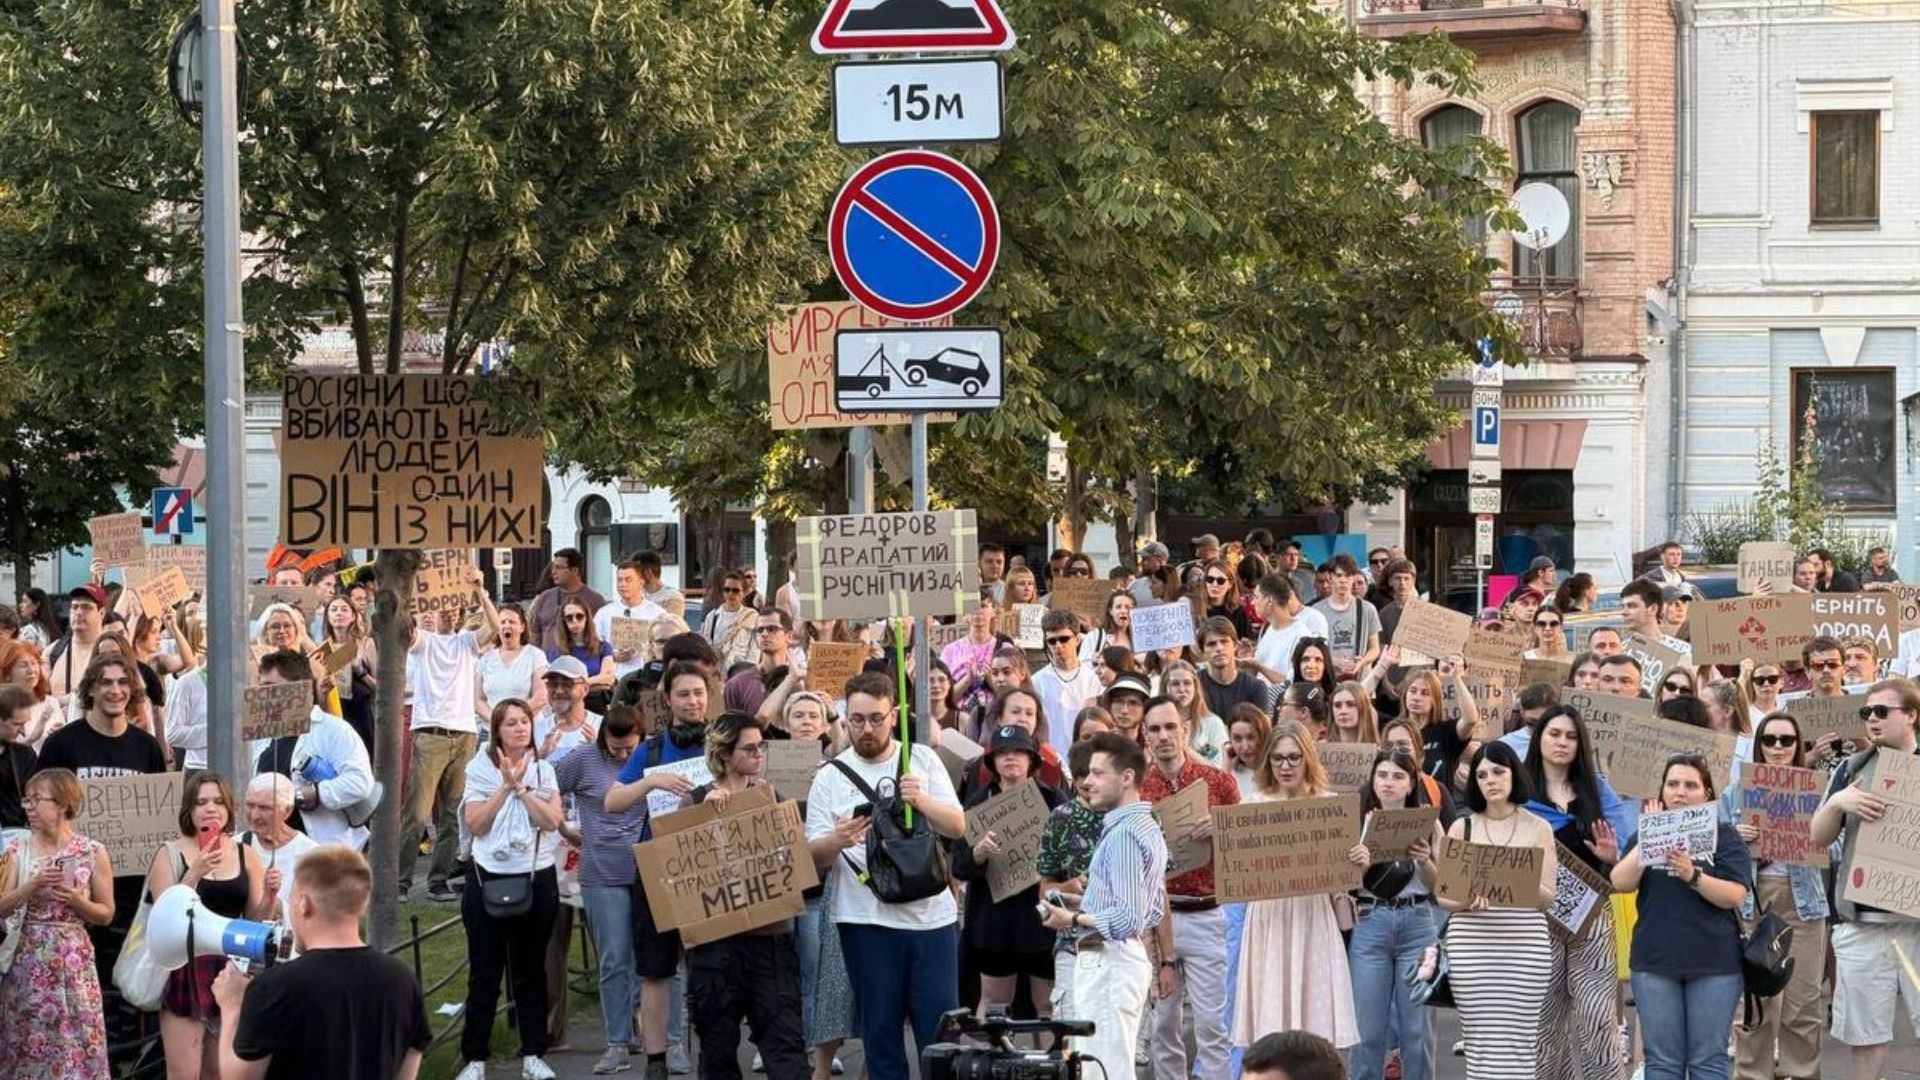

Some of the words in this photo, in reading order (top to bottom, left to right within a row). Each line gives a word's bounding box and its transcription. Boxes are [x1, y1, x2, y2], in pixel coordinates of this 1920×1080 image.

[284, 376, 404, 408] РОСІЯНИ
[287, 408, 448, 440] ВБИВАЮТЬ
[339, 438, 480, 474] ЛЮДЕЙ
[286, 473, 380, 545] ВІН
[411, 469, 514, 504] ОДИН
[394, 504, 429, 544] ІЗ
[447, 503, 536, 544] НИХ!
[818, 514, 937, 538] ФЕДОРОВ
[419, 549, 469, 571] ВЕРН
[820, 543, 948, 567] ДРАПАТИЙ
[822, 573, 885, 599] РУСНІ
[408, 590, 482, 615] ЕДОРОВА
[1811, 593, 1887, 617] ЕРНІТЬ
[1320, 750, 1374, 767] ДОРОВА
[80, 781, 176, 819] ВЕРНИ
[1445, 838, 1534, 872] ВЕТЕРАНА
[701, 865, 794, 919] МЕНЕ?
